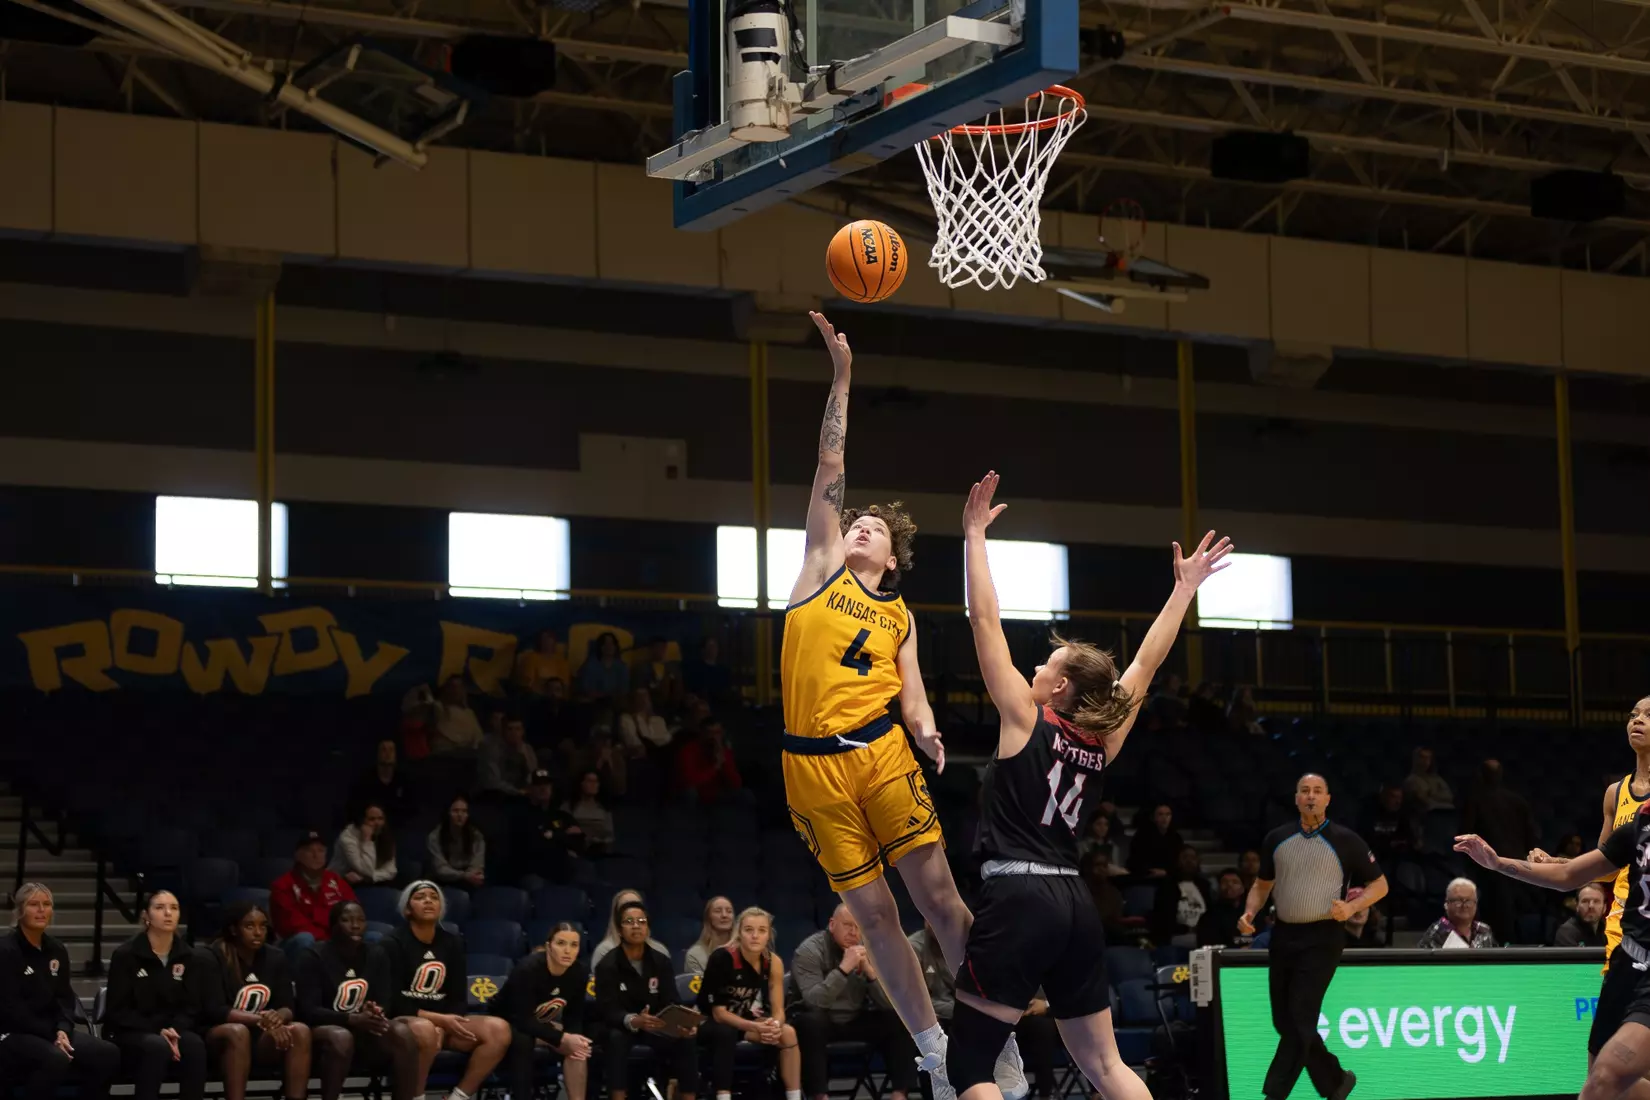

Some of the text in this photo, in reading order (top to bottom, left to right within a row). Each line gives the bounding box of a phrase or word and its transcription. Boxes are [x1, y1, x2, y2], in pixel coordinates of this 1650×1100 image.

[861, 228, 878, 264] NCAA
[826, 591, 877, 624] KANSAS
[18, 606, 410, 699] ROWDY
[840, 628, 873, 676] 4
[1040, 759, 1087, 837] 14
[1339, 1005, 1517, 1063] evergy
